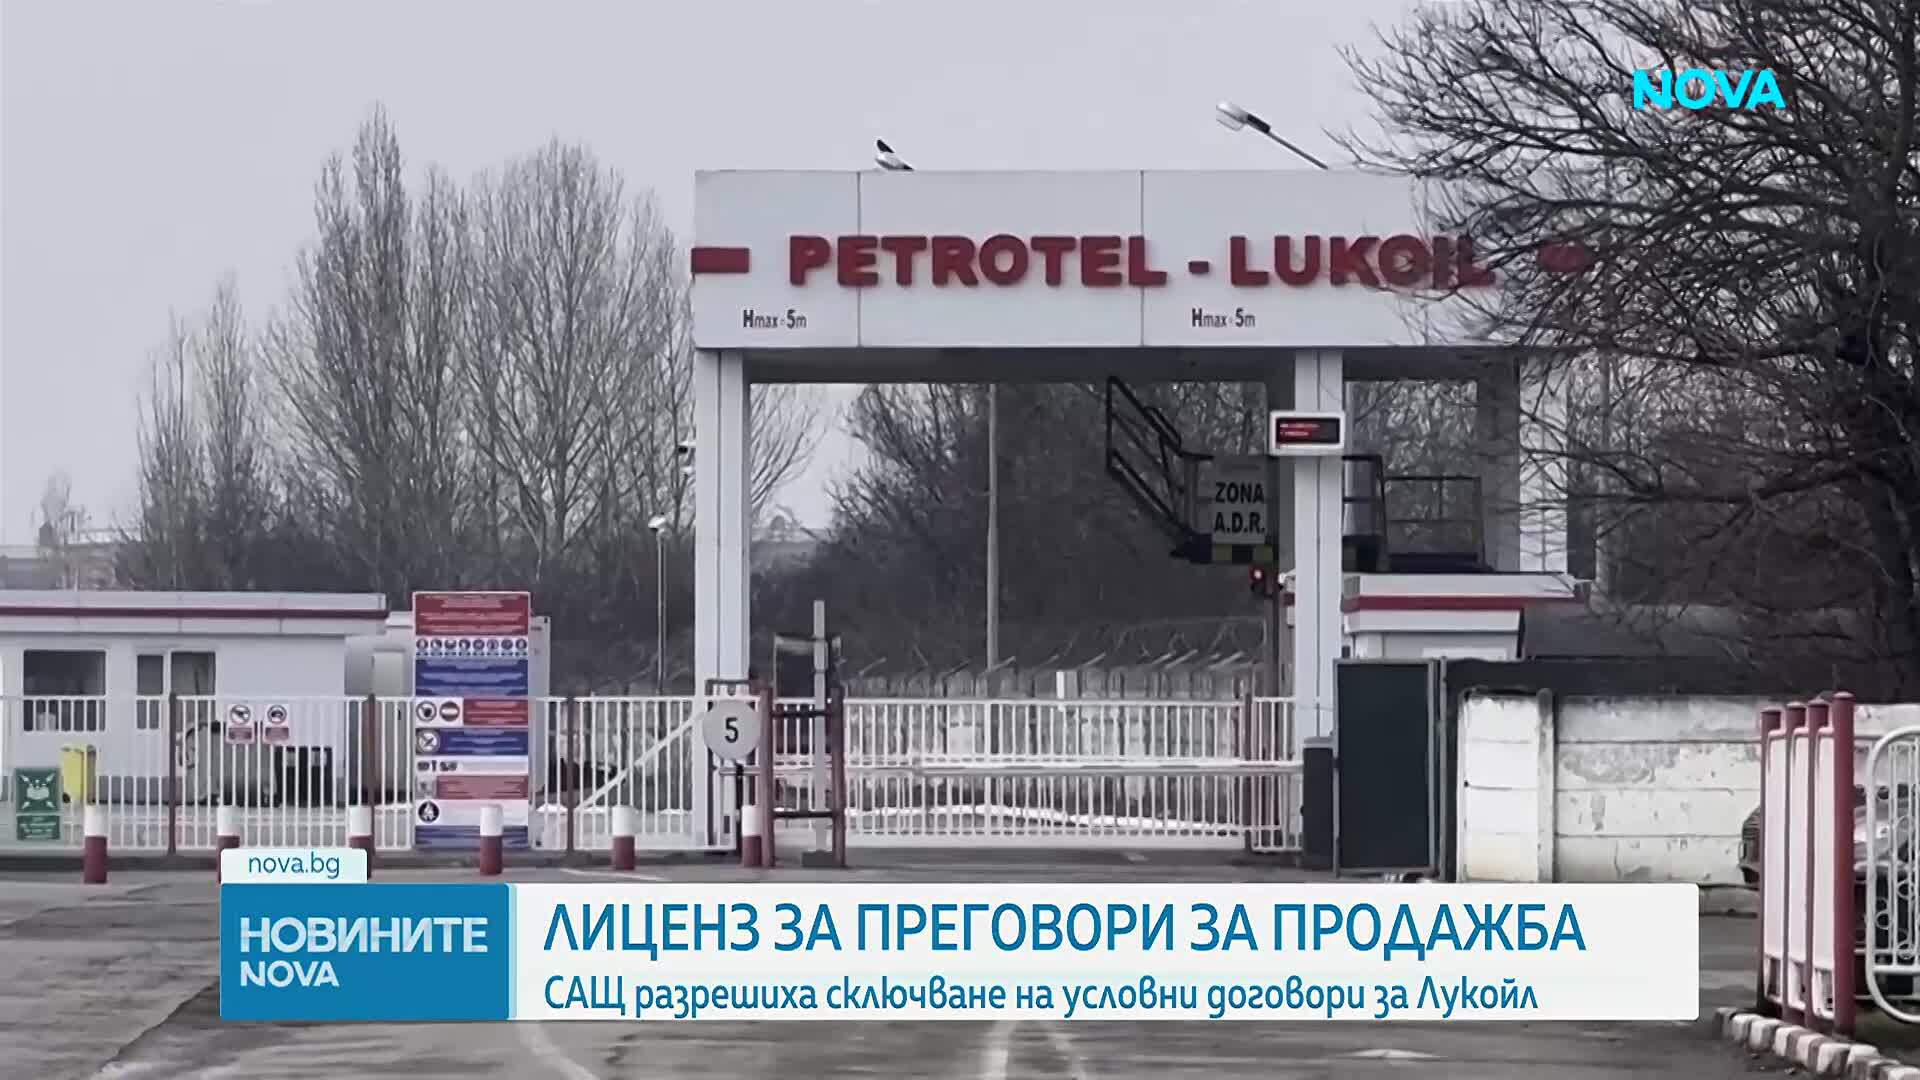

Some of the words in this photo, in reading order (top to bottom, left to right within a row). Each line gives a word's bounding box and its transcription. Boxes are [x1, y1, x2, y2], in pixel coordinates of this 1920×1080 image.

[789, 234, 1167, 288] PETROTEL
[1229, 234, 1497, 288] LUKOIL
[1215, 482, 1265, 504] ZONA
[1215, 511, 1266, 534] A.D.R.
[724, 717, 740, 744] 5
